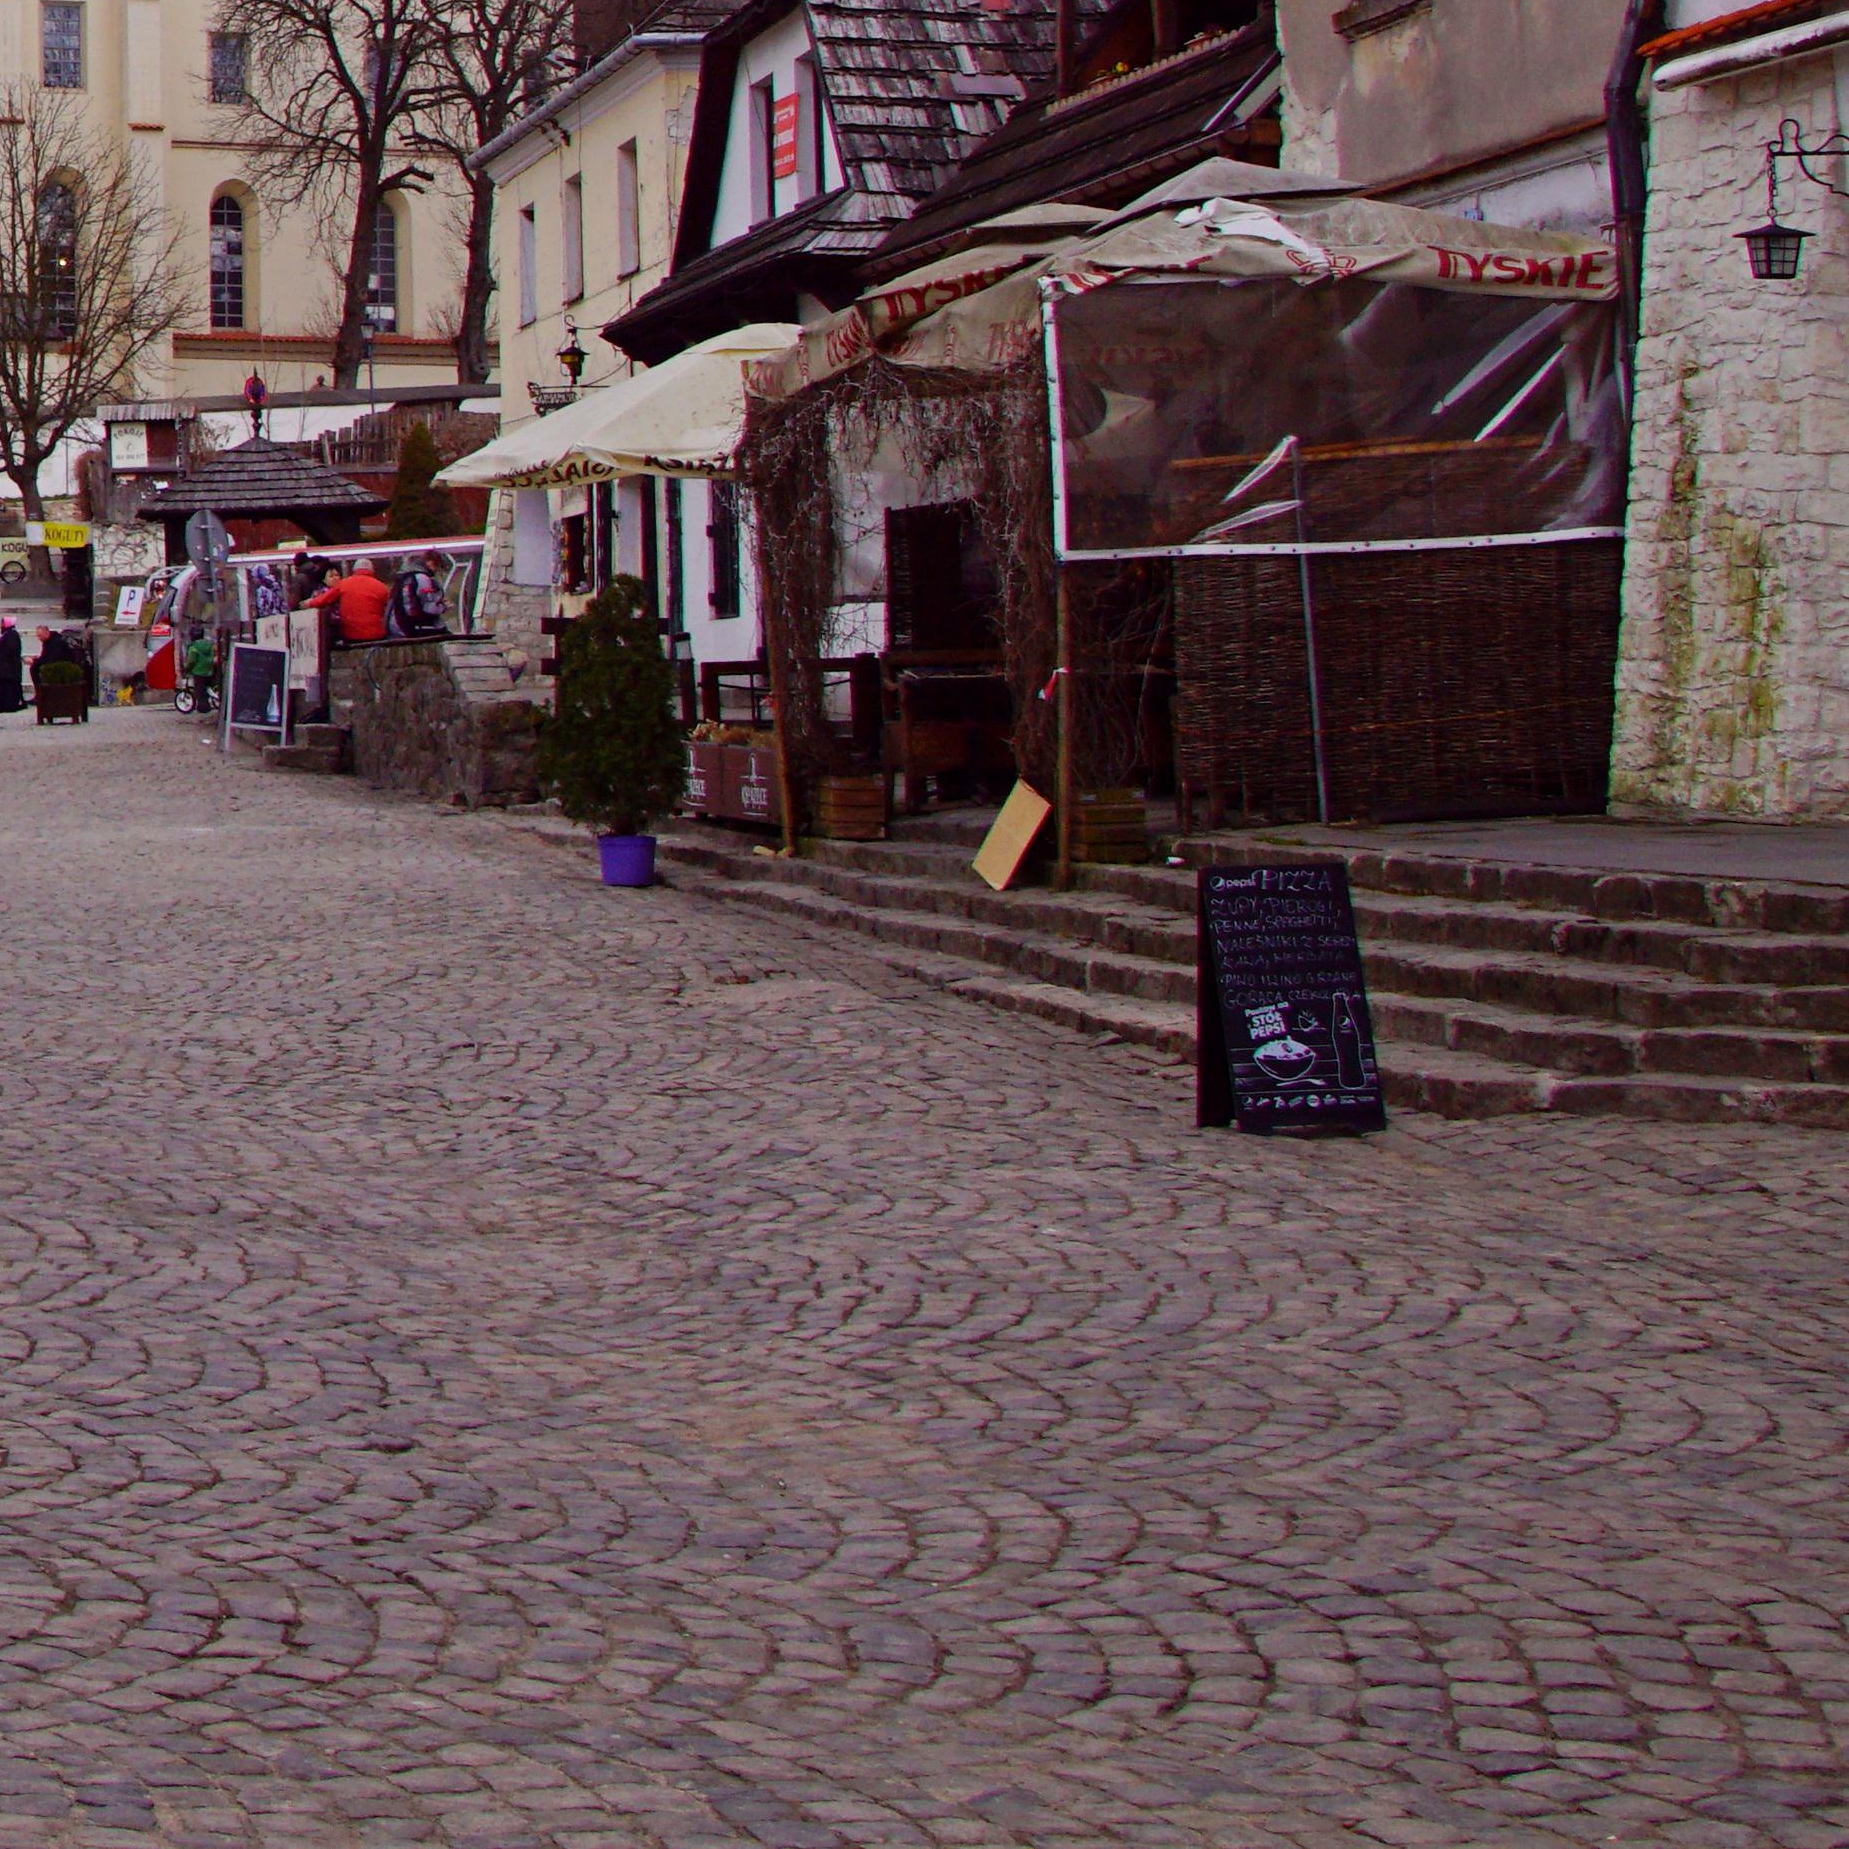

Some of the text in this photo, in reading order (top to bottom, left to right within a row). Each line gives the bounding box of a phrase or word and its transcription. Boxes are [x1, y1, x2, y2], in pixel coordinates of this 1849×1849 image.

[1427, 245, 1609, 289] TYSKIE
[44, 528, 85, 543] KOGUTY
[126, 589, 136, 607] P
[1225, 869, 1332, 892] pepsi PIZZA
[1249, 1021, 1286, 1040] PEPSI
